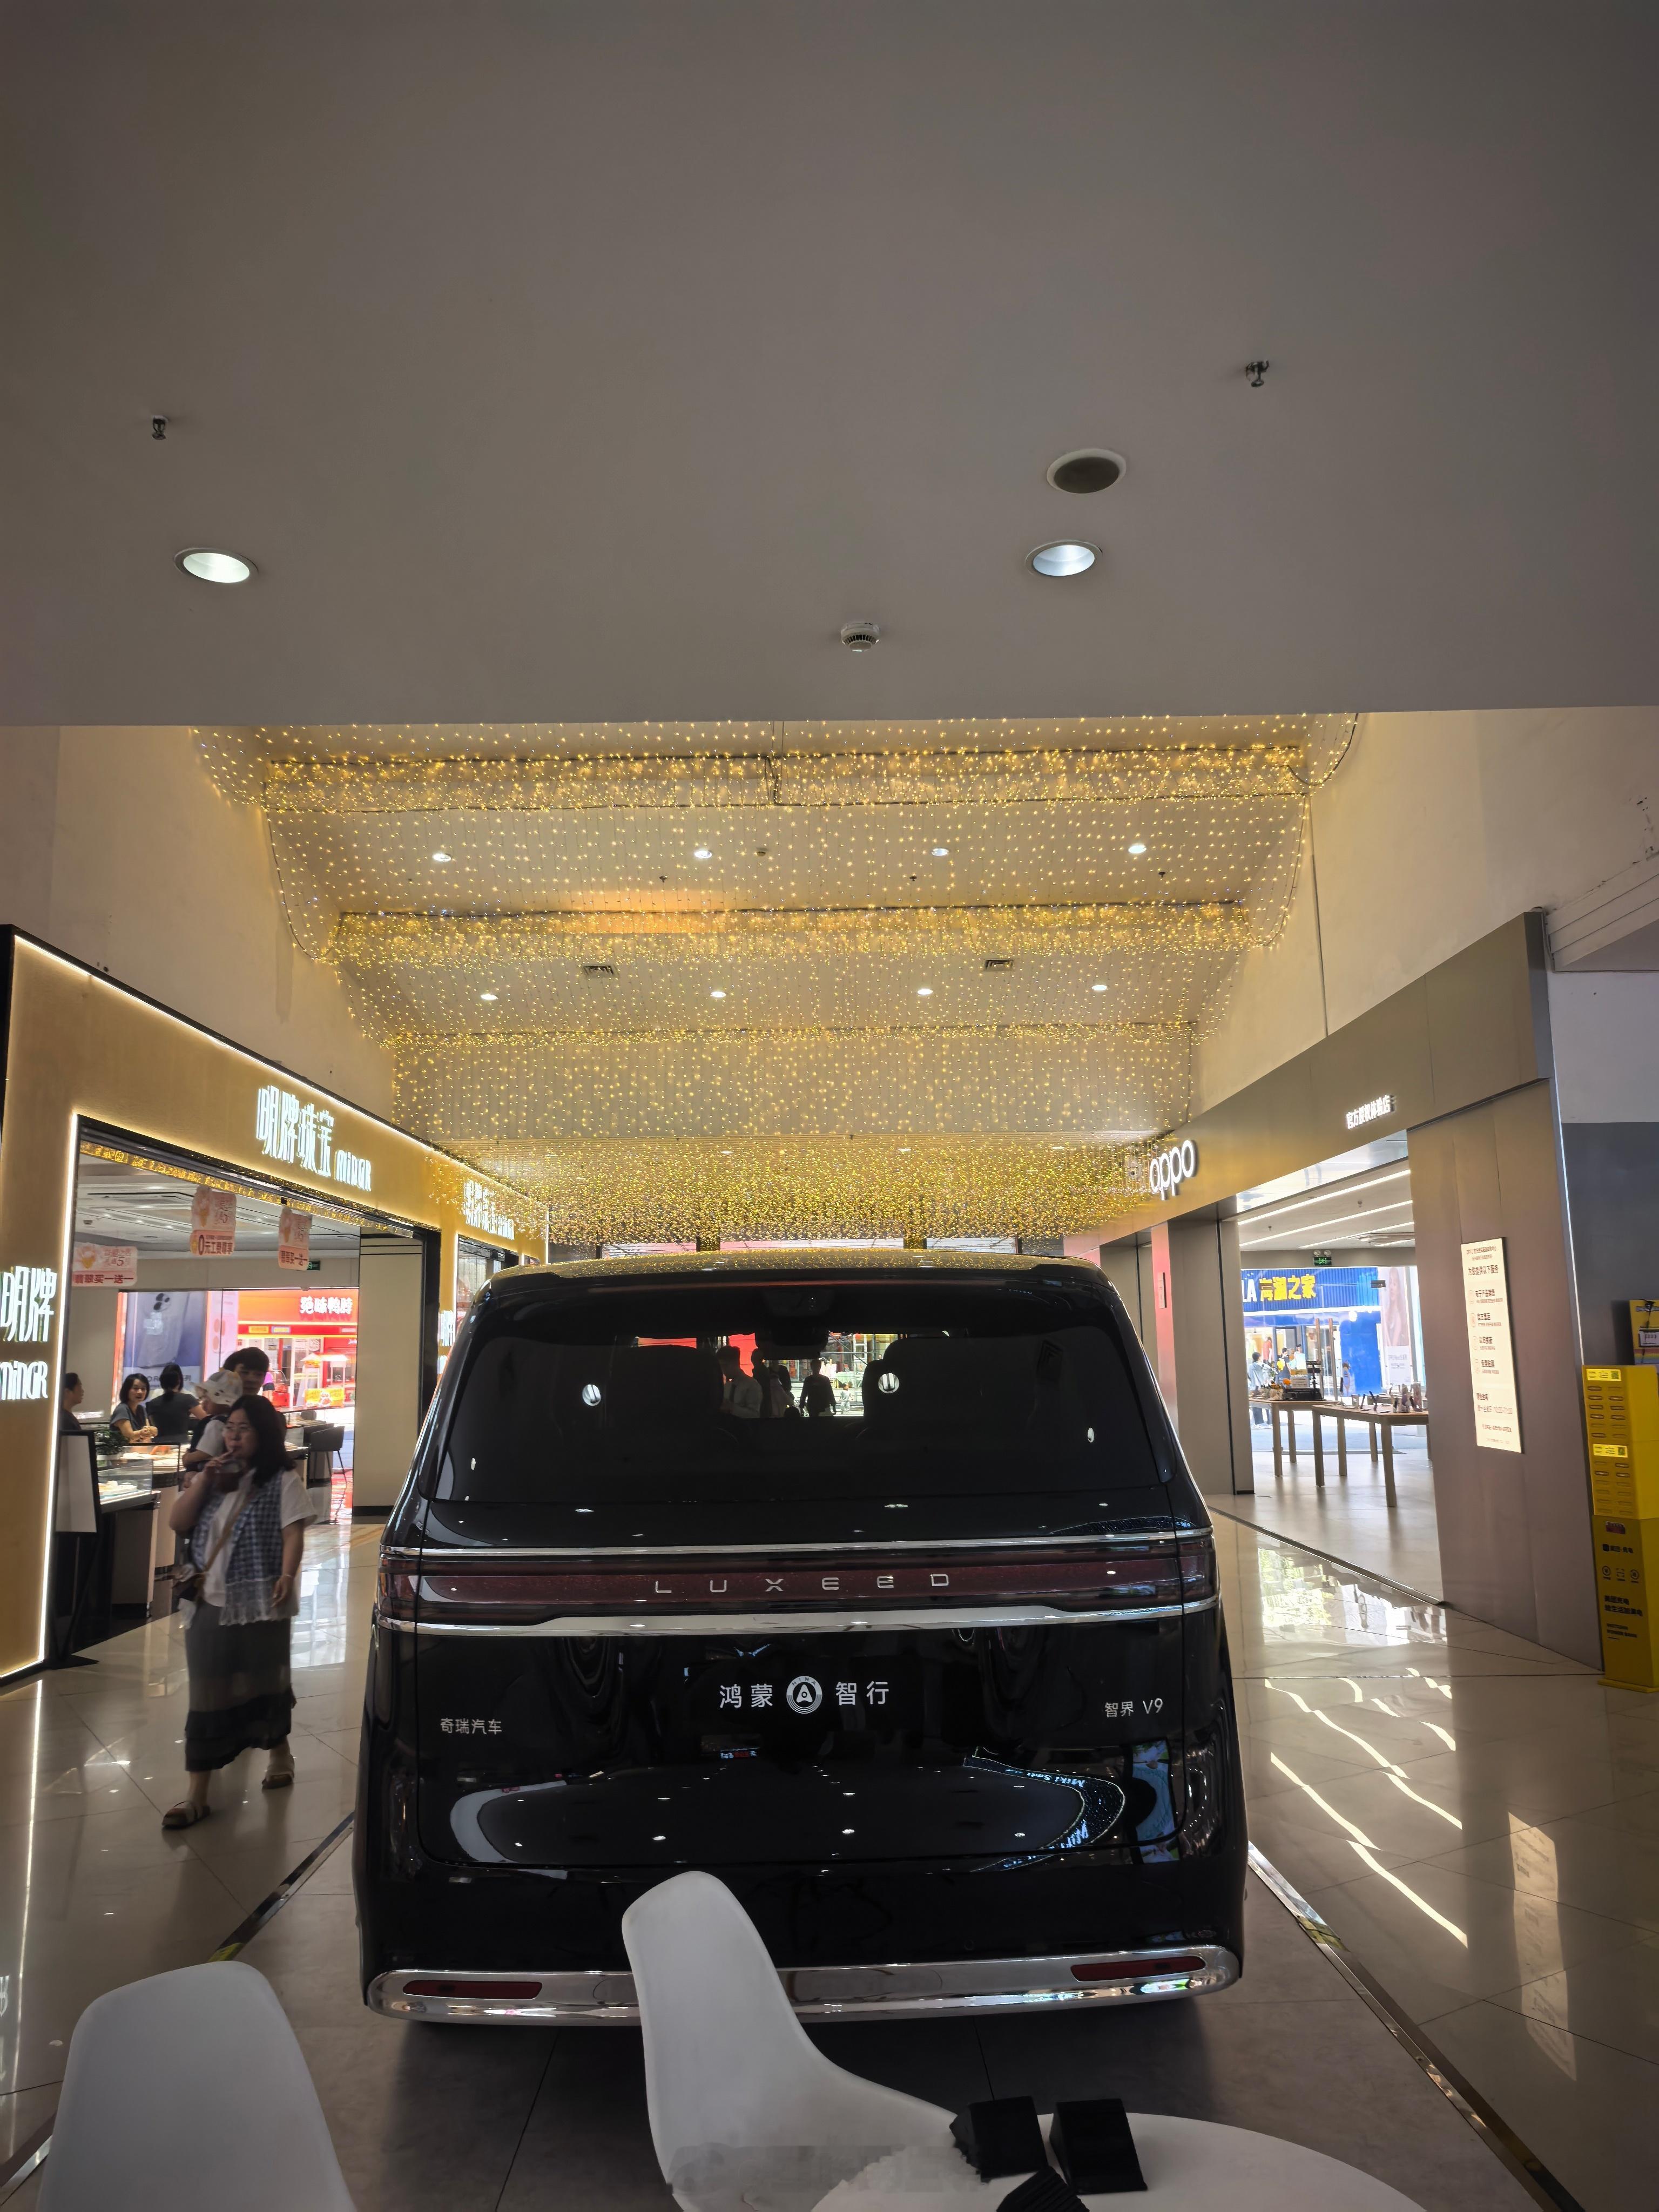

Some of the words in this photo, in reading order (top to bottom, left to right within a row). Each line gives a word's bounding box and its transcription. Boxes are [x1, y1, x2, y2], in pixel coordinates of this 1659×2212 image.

[1346, 1095, 1391, 1129] 官方授权体验店
[256, 1085, 334, 1177] 明牌珠宝
[655, 1574, 949, 1593] LUXEED
[719, 1683, 773, 1708] 鸿蒙
[835, 1681, 889, 1705] 智行
[1105, 1701, 1134, 1717] 智界
[1142, 1698, 1163, 1714] V9
[440, 1718, 502, 1735] 奇瑞汽车
